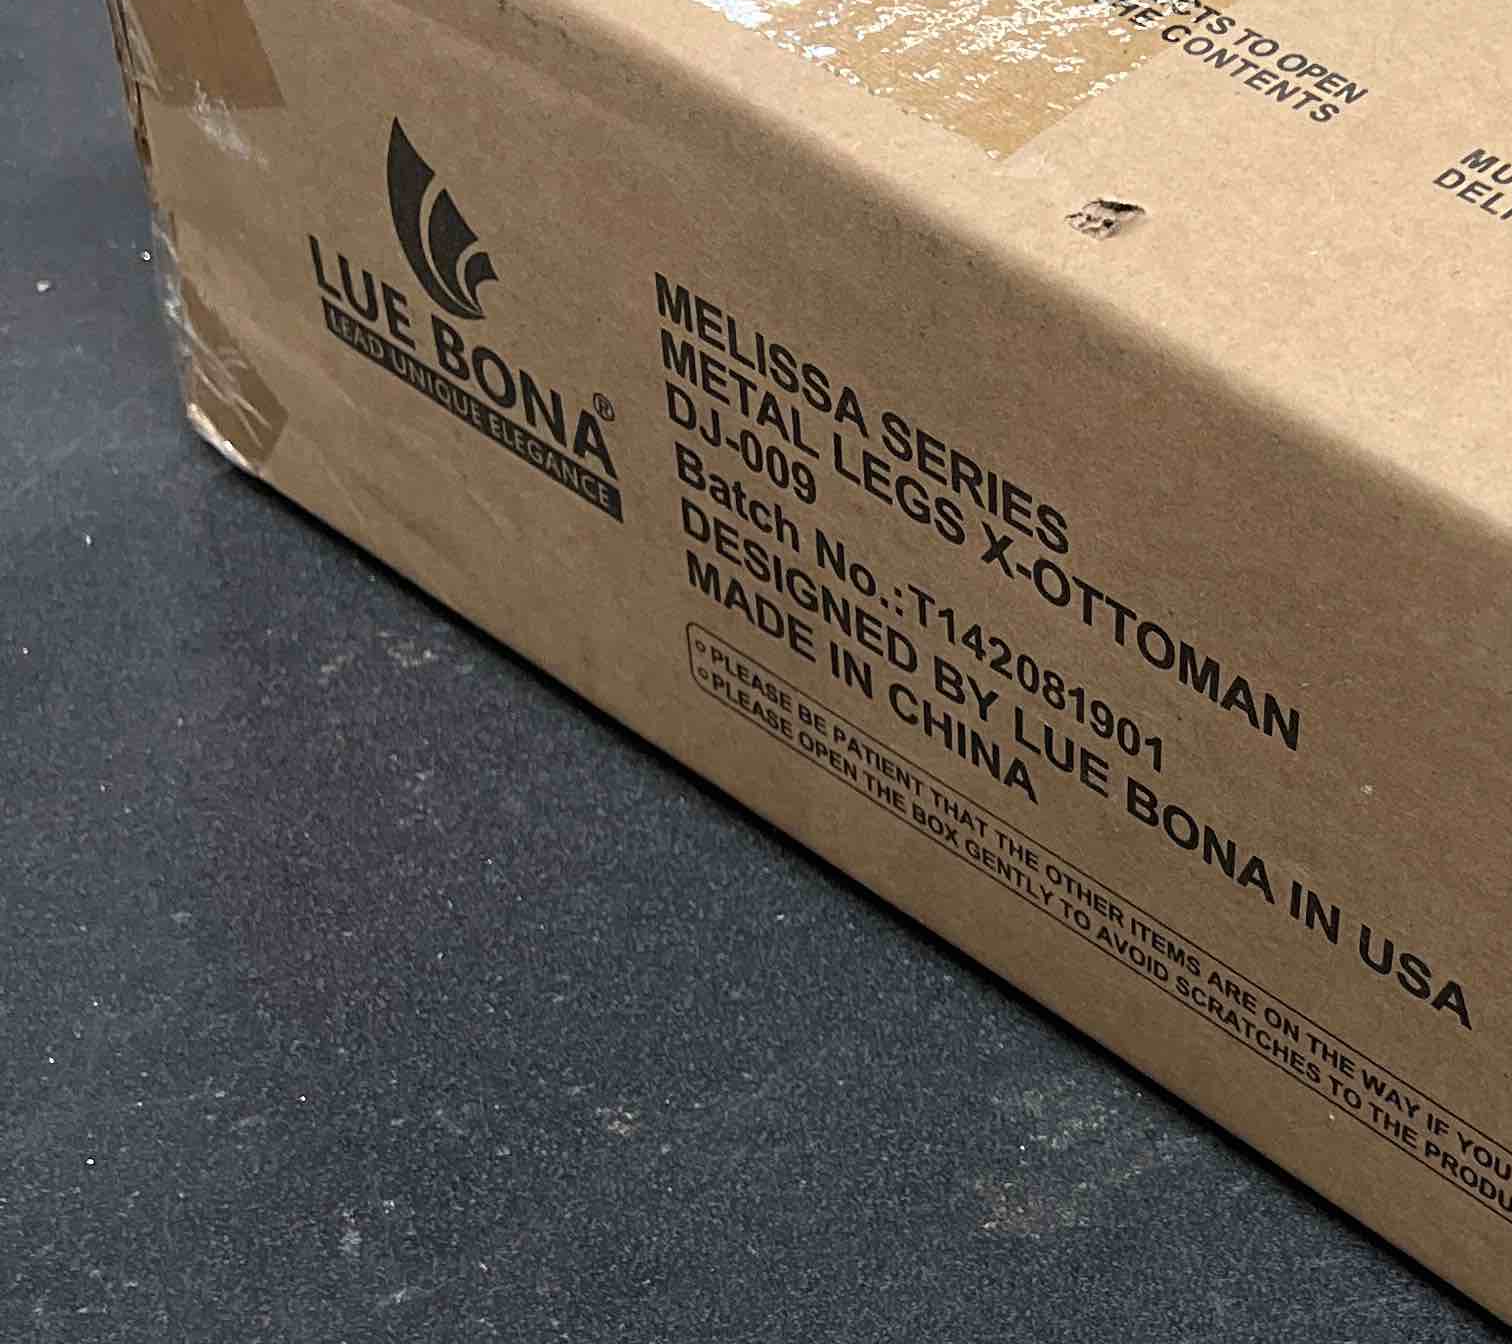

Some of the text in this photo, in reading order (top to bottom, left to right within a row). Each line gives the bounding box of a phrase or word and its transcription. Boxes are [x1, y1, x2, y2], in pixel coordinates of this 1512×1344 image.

[1161, 23, 1341, 124] CONTENTS
[1233, 26, 1280, 58] TO
[1276, 53, 1369, 106] OPEN
[308, 233, 416, 351] LUE
[330, 308, 610, 507] LEAD UNIQUE ELEGANCE
[654, 271, 1070, 555] MELISSA SERIES
[665, 380, 817, 506] DJ-009
[674, 441, 801, 553] Batch
[659, 328, 1300, 752] METAL LEGS X-OTTOMAN
[680, 496, 1474, 1032] DESIGNED BY LUE BONA IN USA
[686, 548, 1039, 806] MADE IN CHINA
[710, 645, 793, 714] PLEASE
[797, 703, 827, 736] BE
[832, 725, 925, 797] PATIENT
[929, 785, 989, 839] THAT
[994, 829, 1040, 873] THE
[1044, 862, 1125, 929] OTHER
[1130, 917, 1202, 977] ITEMS
[1206, 970, 1258, 1016] ARE
[1263, 1008, 1300, 1041] ON
[1306, 1032, 1355, 1080] THE
[1360, 1069, 1421, 1120] WAY
[1425, 1113, 1451, 1139] IF
[1456, 1130, 1512, 1182] YOU
[711, 671, 794, 741] PLEASE
[797, 730, 858, 782] OPEN
[861, 769, 907, 814] THE
[911, 803, 959, 848] BOX
[964, 838, 1054, 907] GENTLY
[1059, 897, 1091, 932] TO
[1096, 924, 1170, 982] AVOID
[1174, 974, 1321, 1085] SCRATCHES
[1327, 1074, 1362, 1111] TO
[1368, 1101, 1418, 1150] THE
